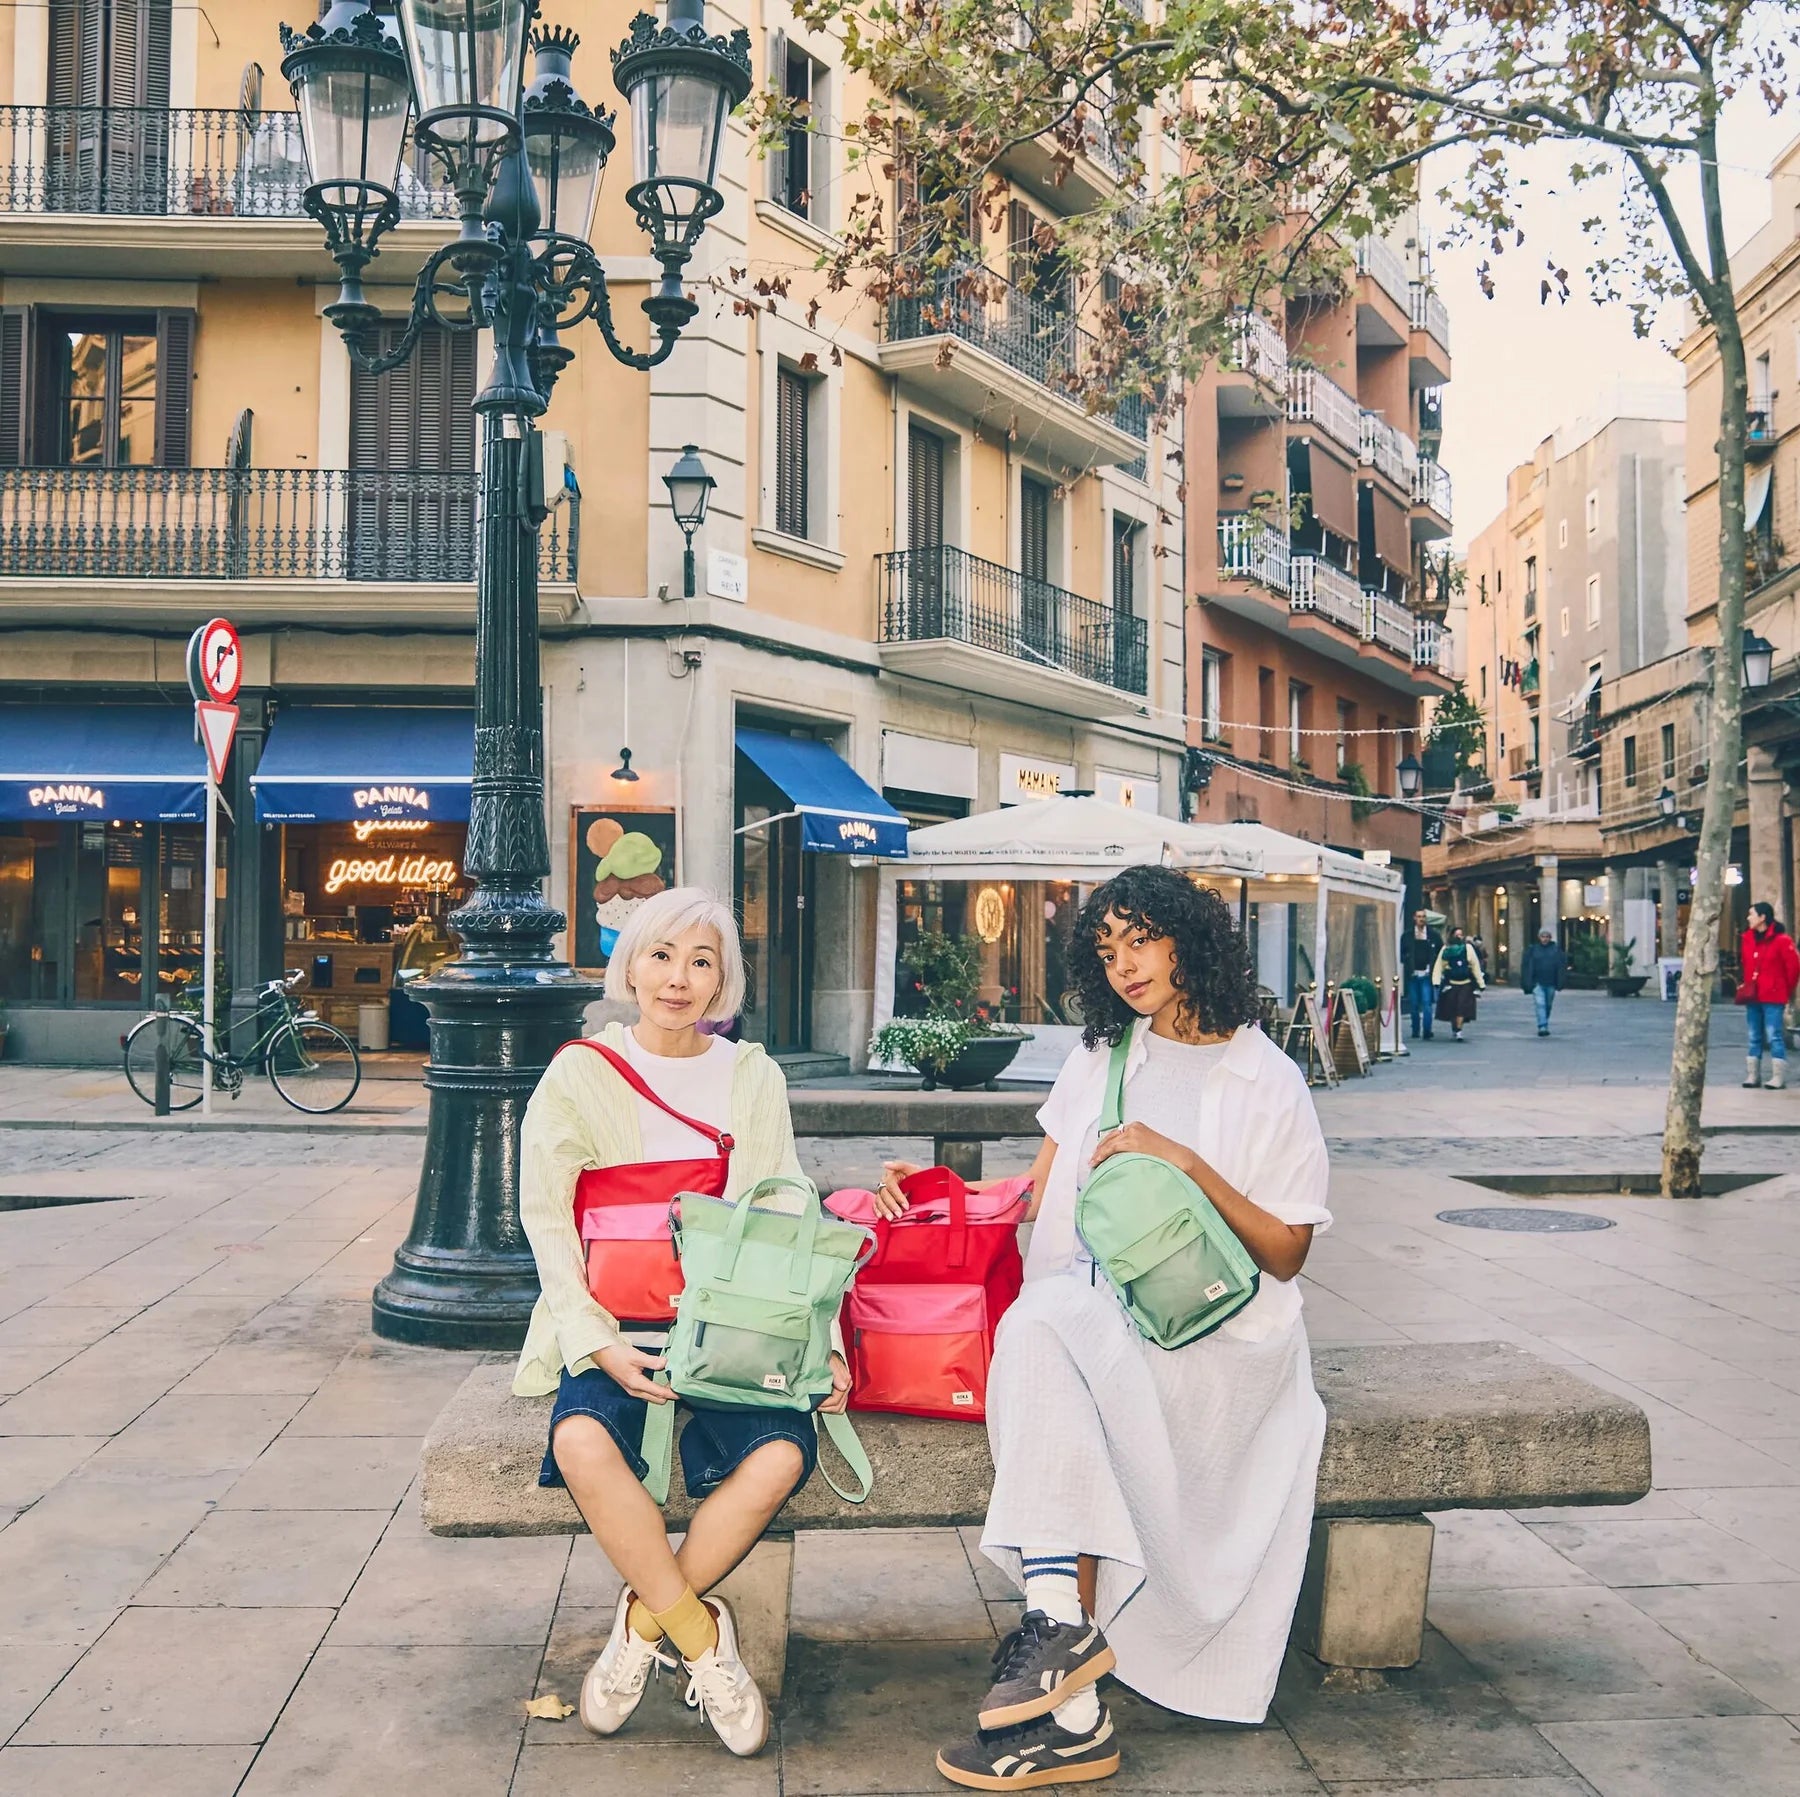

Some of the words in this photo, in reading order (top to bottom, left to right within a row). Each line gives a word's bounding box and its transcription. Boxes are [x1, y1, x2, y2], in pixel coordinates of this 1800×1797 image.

[28, 785, 103, 808] PANNA
[353, 786, 429, 810] PANNA
[838, 821, 877, 844] PANNA
[325, 855, 396, 893] good
[397, 855, 457, 883] idea
[1020, 1744, 1046, 1756] Reebok
